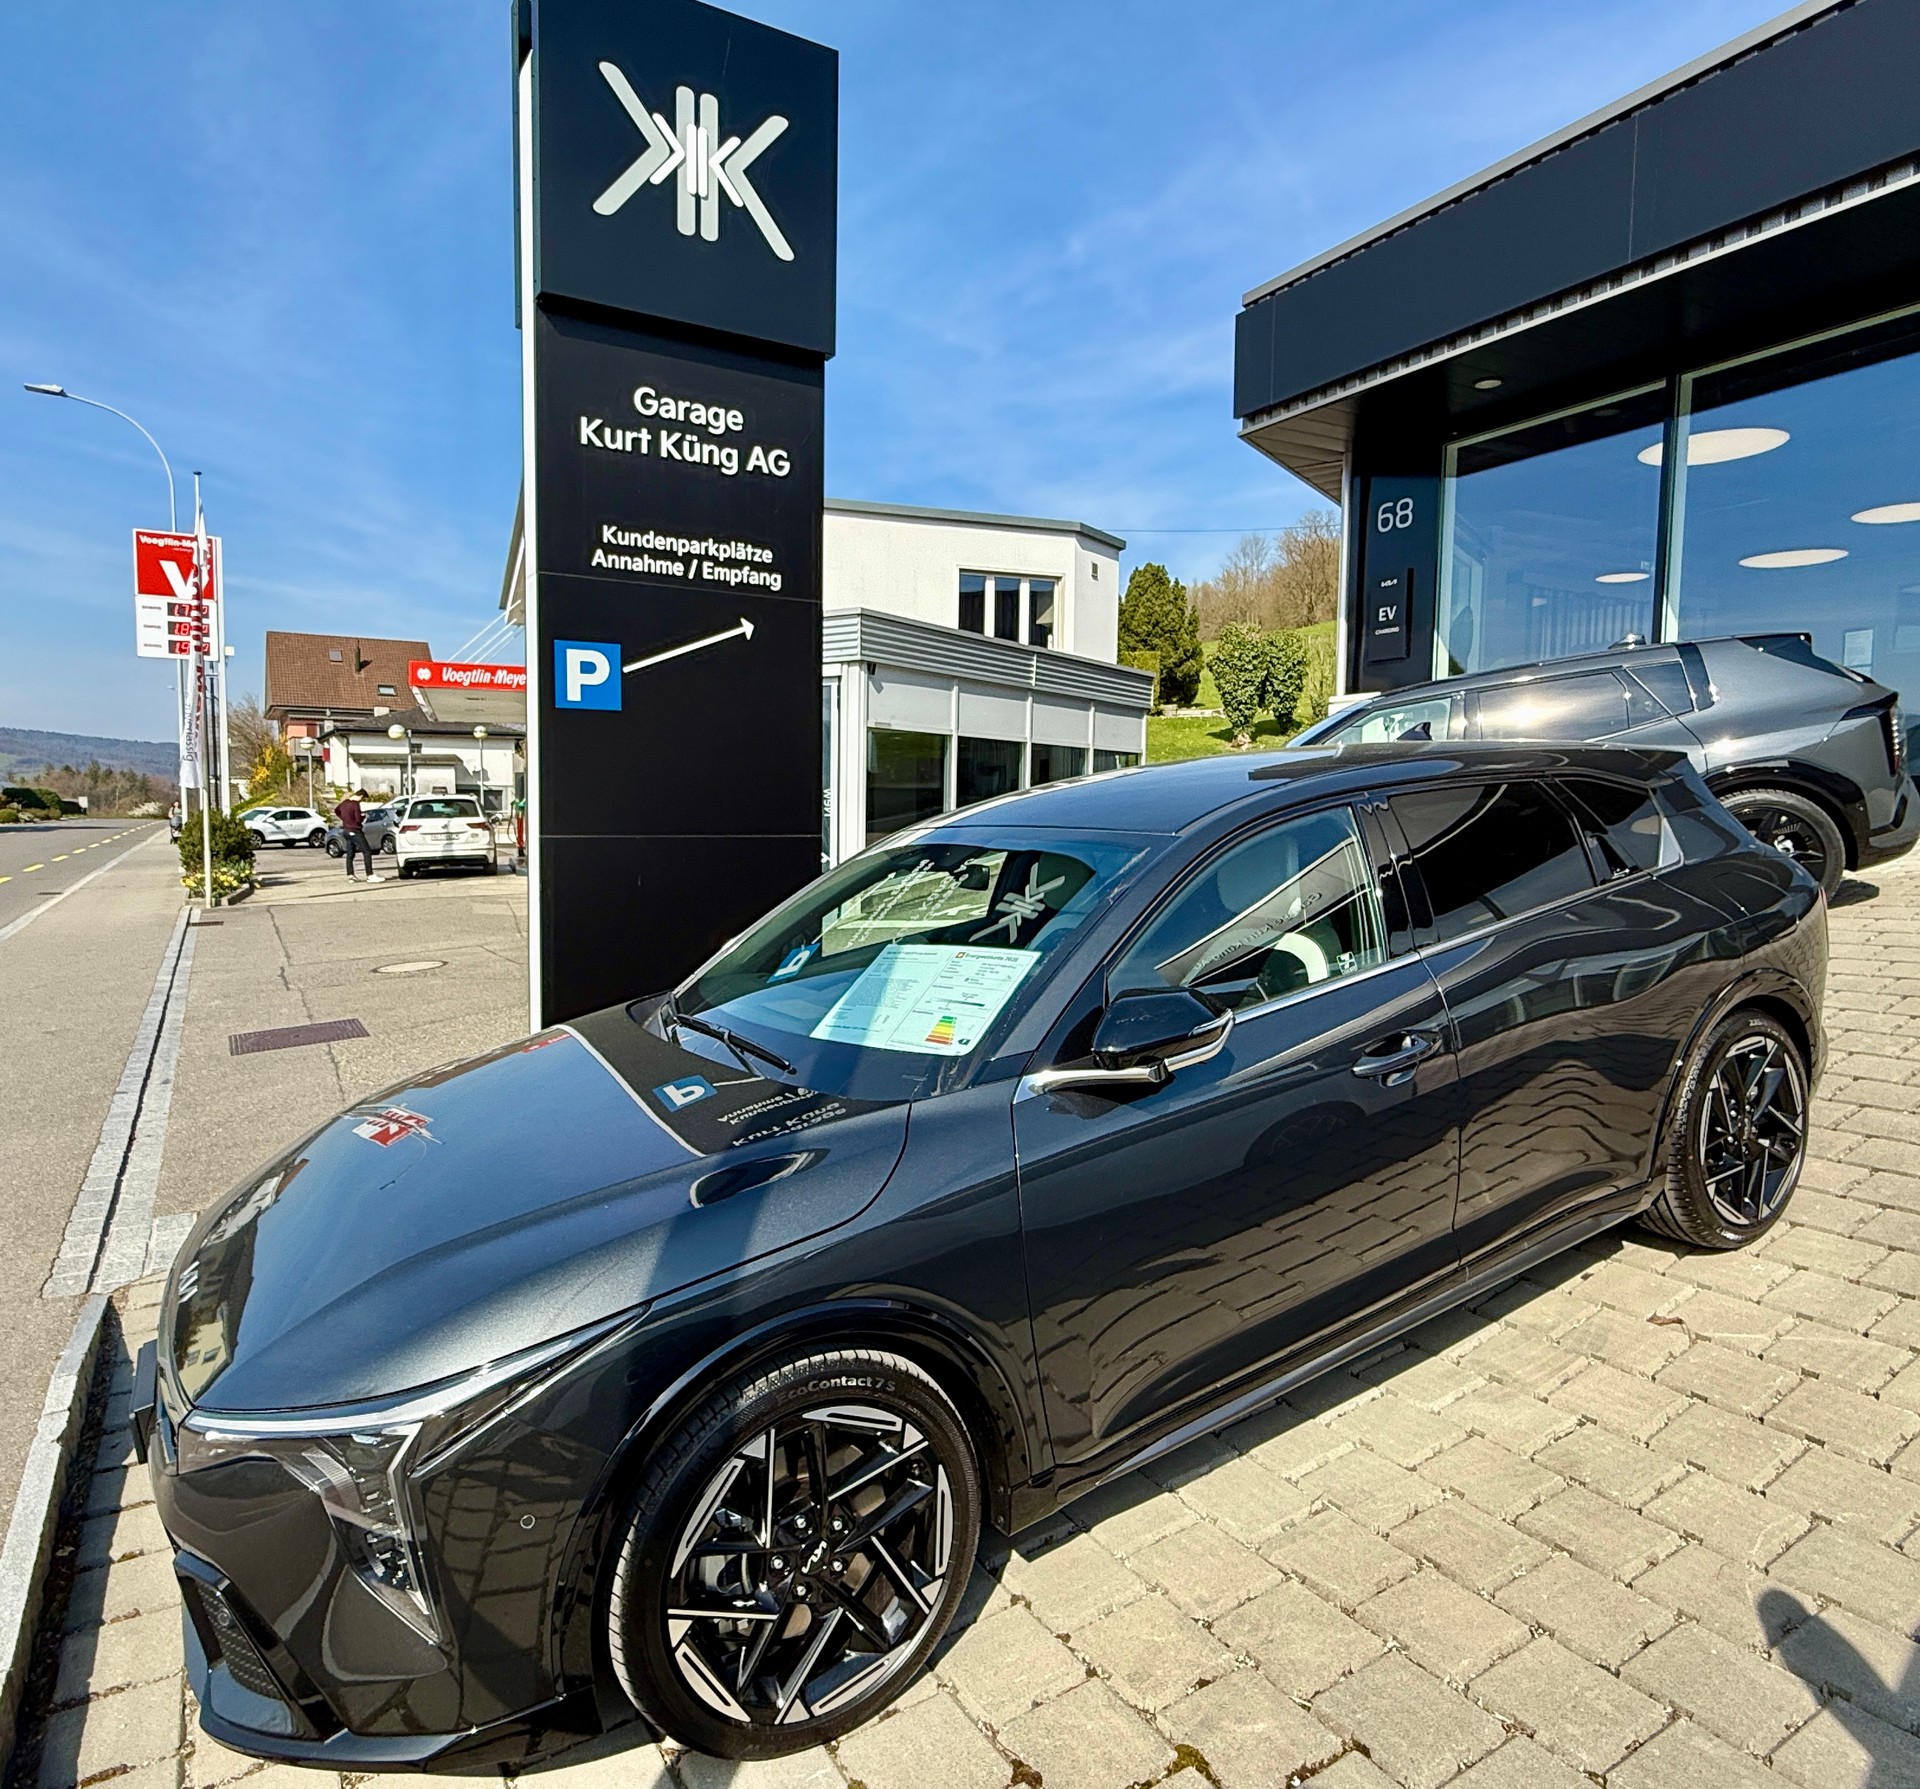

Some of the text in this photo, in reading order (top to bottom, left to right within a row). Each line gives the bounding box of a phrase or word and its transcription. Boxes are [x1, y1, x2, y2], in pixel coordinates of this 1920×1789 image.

[633, 386, 744, 435] Garage
[579, 416, 791, 477] Kurt Küng AG
[1377, 498, 1414, 532] 68
[602, 525, 773, 564] Kundenparkplätze
[591, 549, 782, 591] Annahme / Empfang
[1378, 605, 1397, 622] EV
[442, 666, 526, 689] Voegtlin-Meye
[566, 648, 610, 702] P
[775, 1376, 872, 1402] EcoContact
